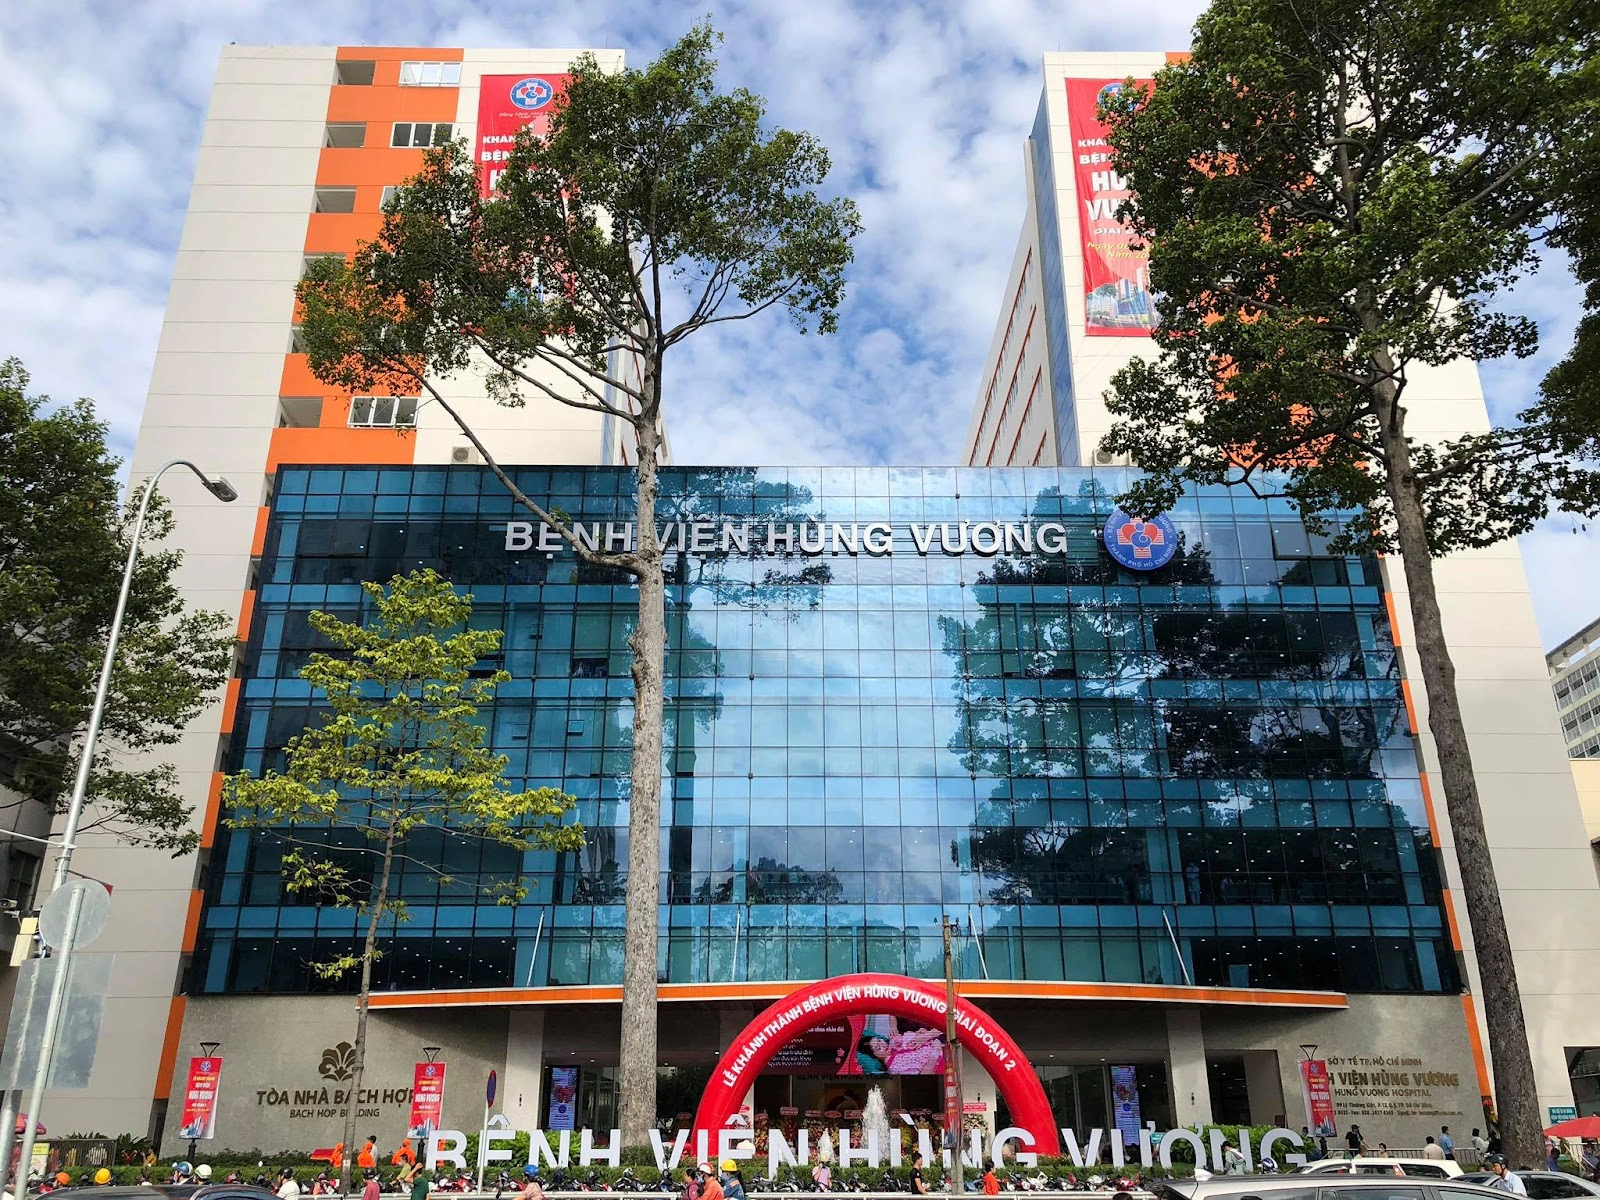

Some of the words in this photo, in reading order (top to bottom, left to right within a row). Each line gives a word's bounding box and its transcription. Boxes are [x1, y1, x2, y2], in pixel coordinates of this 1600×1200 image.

[482, 134, 516, 144] KHÁN
[1078, 137, 1107, 147] KHÁ
[481, 149, 511, 164] BỆN
[504, 518, 634, 560] BỆNH
[656, 516, 750, 560] VIỆN
[767, 514, 893, 557] HÙNG
[910, 517, 1069, 557] VƯƠNG
[722, 1069, 738, 1088] LỄ
[731, 1031, 768, 1075] KHÁNH
[763, 1005, 804, 1038] THÀNH
[802, 991, 834, 1013] BỆNH
[834, 984, 861, 1003] VIỆN
[864, 982, 899, 1000] HÙNG
[974, 1025, 1009, 1062] ĐOẠN
[1004, 1059, 1017, 1072] 2
[1340, 1057, 1346, 1065] Y
[1347, 1055, 1358, 1066] TẾ
[1386, 1056, 1400, 1066] CHÍ
[1401, 1058, 1422, 1066] MINH
[1338, 1069, 1368, 1089] VIỆN
[1371, 1068, 1409, 1086] HÙNG
[1412, 1070, 1460, 1087] VƯƠNG
[256, 1087, 290, 1106] TÒA
[293, 1086, 329, 1105] NHÀ
[1334, 1088, 1359, 1097] HUNG
[1360, 1088, 1390, 1097] VUONG
[1391, 1089, 1432, 1097] HOSPITAL
[289, 1109, 314, 1119] BACH
[316, 1109, 337, 1118] HOP
[339, 1108, 380, 1118] BDING
[425, 1113, 621, 1170] BỆNH
[648, 1113, 809, 1180] VIỆN
[838, 1113, 1038, 1168] HÙNG
[1060, 1120, 1307, 1172] VƯƠNG
